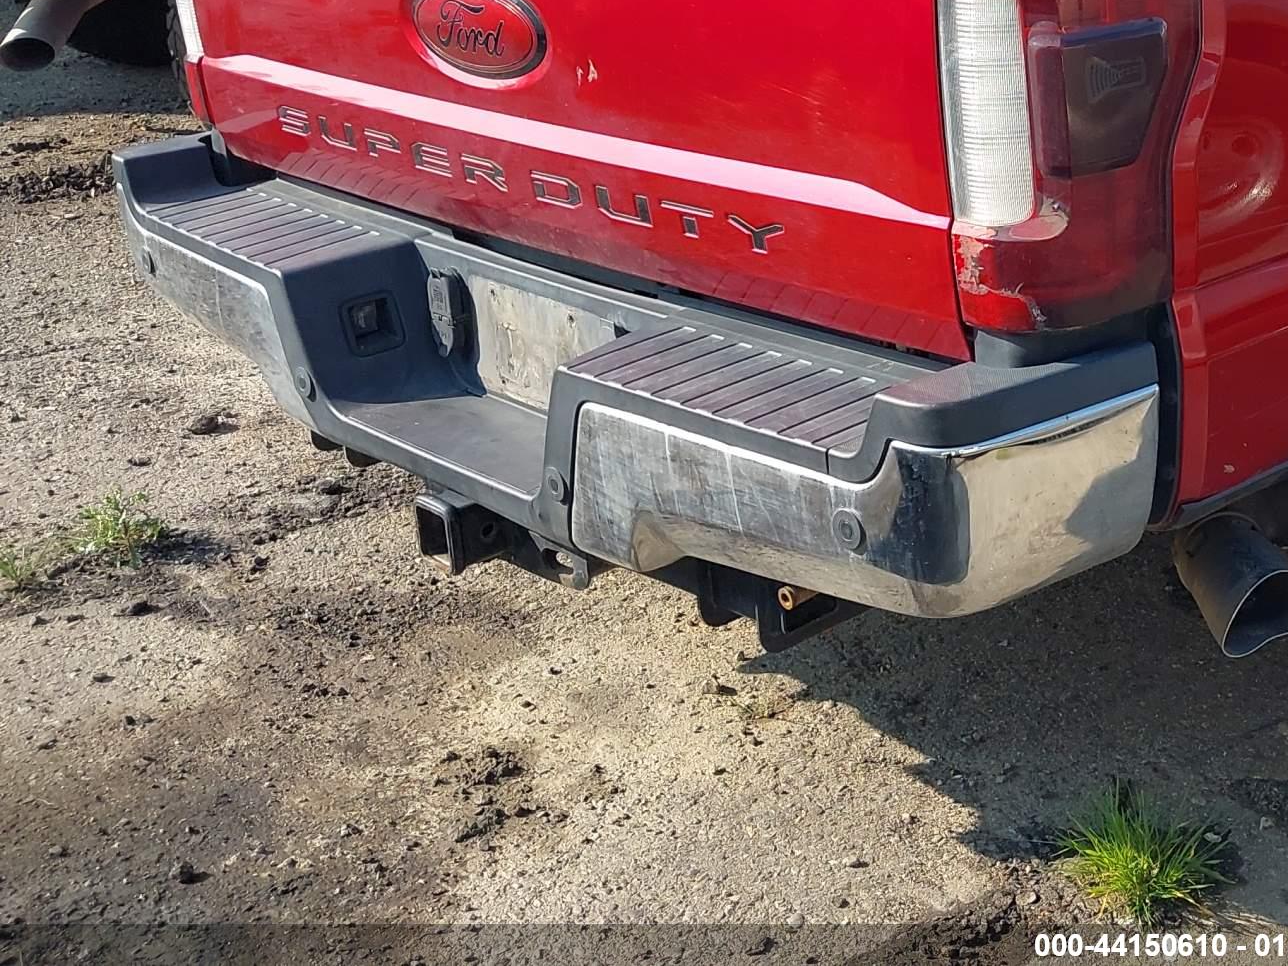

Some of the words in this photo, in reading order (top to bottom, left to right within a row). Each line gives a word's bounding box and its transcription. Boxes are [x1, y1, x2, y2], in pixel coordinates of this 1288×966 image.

[437, 0, 505, 57] Ford
[277, 104, 508, 193] SUPER
[530, 169, 785, 255] DUTY
